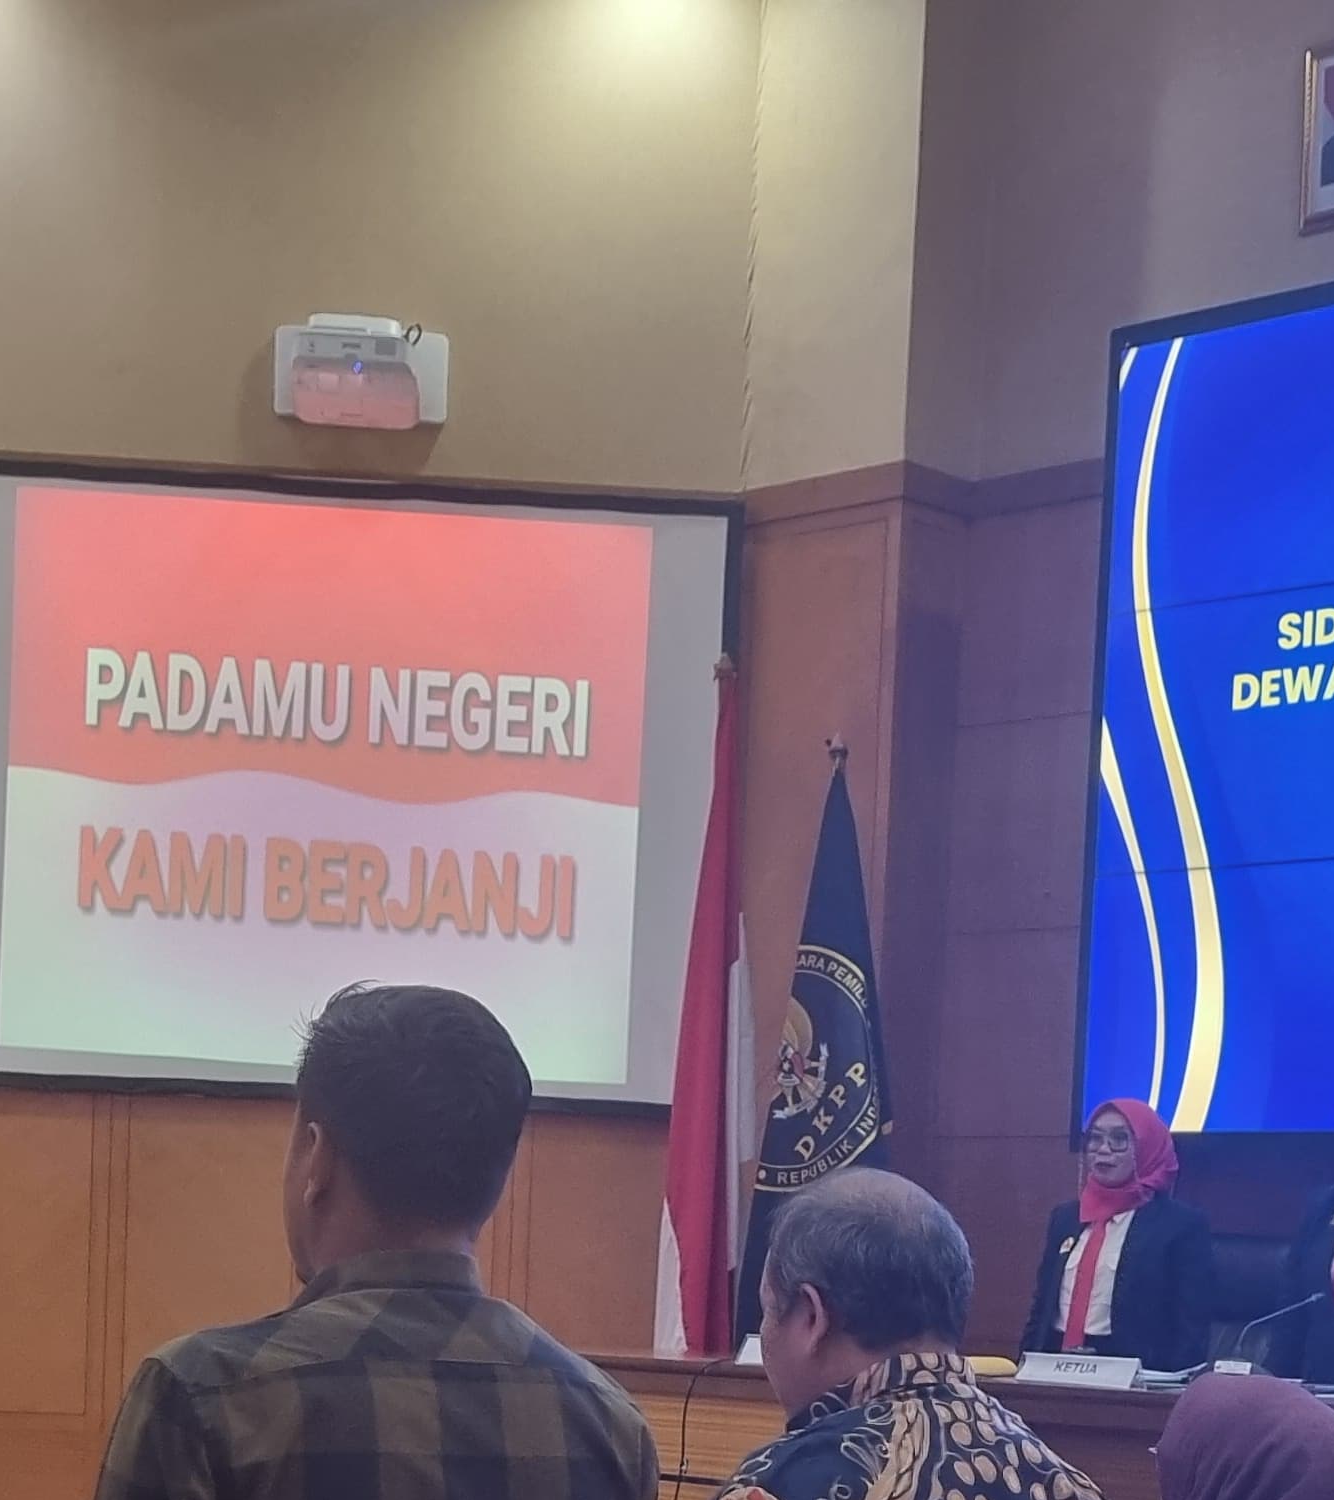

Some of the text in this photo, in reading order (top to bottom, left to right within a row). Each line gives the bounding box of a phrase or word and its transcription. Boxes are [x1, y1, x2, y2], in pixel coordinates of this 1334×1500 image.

[84, 647, 590, 757] PADAMU NEGERI
[77, 825, 575, 939] KAMI BERJANJI
[794, 1062, 867, 1160] DKPP
[777, 1139, 855, 1184] REPUBLIK
[1053, 1361, 1098, 1374] KETUA
